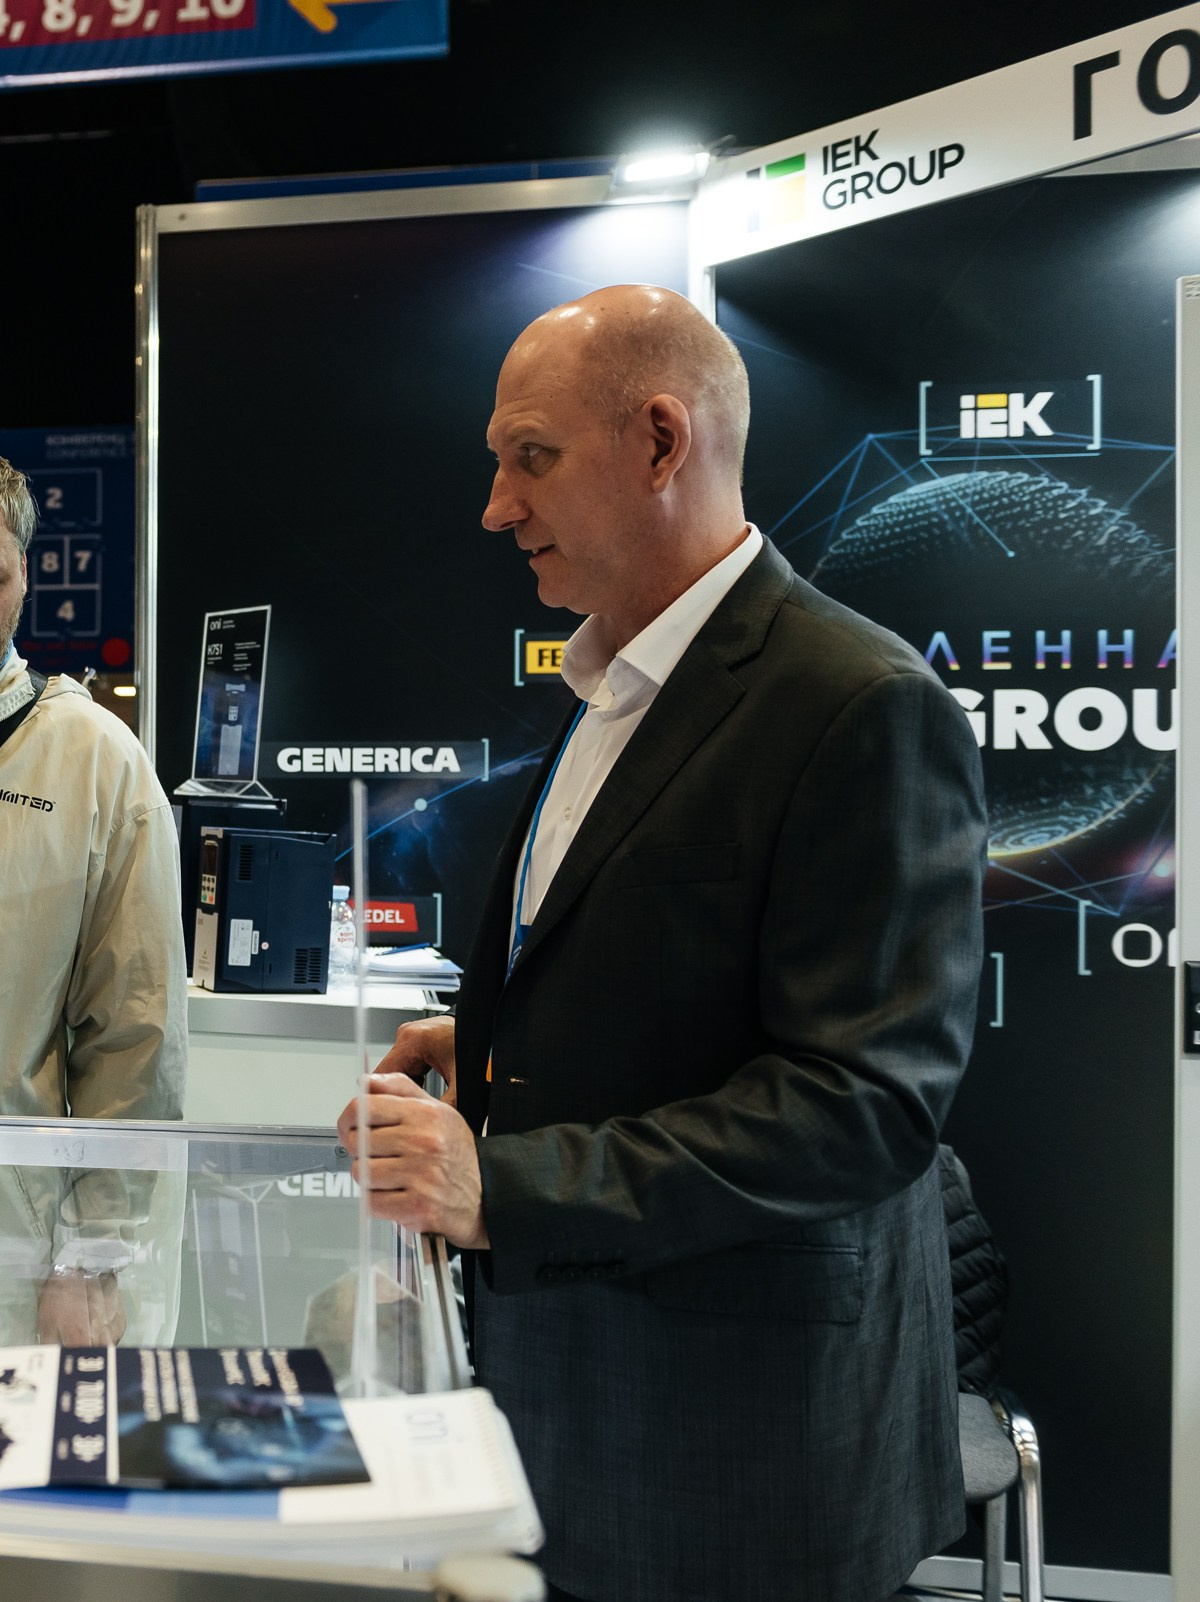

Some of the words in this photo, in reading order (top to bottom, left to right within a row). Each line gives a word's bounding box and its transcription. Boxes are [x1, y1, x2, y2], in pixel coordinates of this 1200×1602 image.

[822, 128, 880, 176] IEK
[821, 142, 965, 211] GROUP
[44, 486, 65, 511] 2
[41, 551, 61, 574] 8
[73, 550, 93, 574] 7
[56, 599, 76, 623] 4
[276, 746, 461, 773] GENERICA
